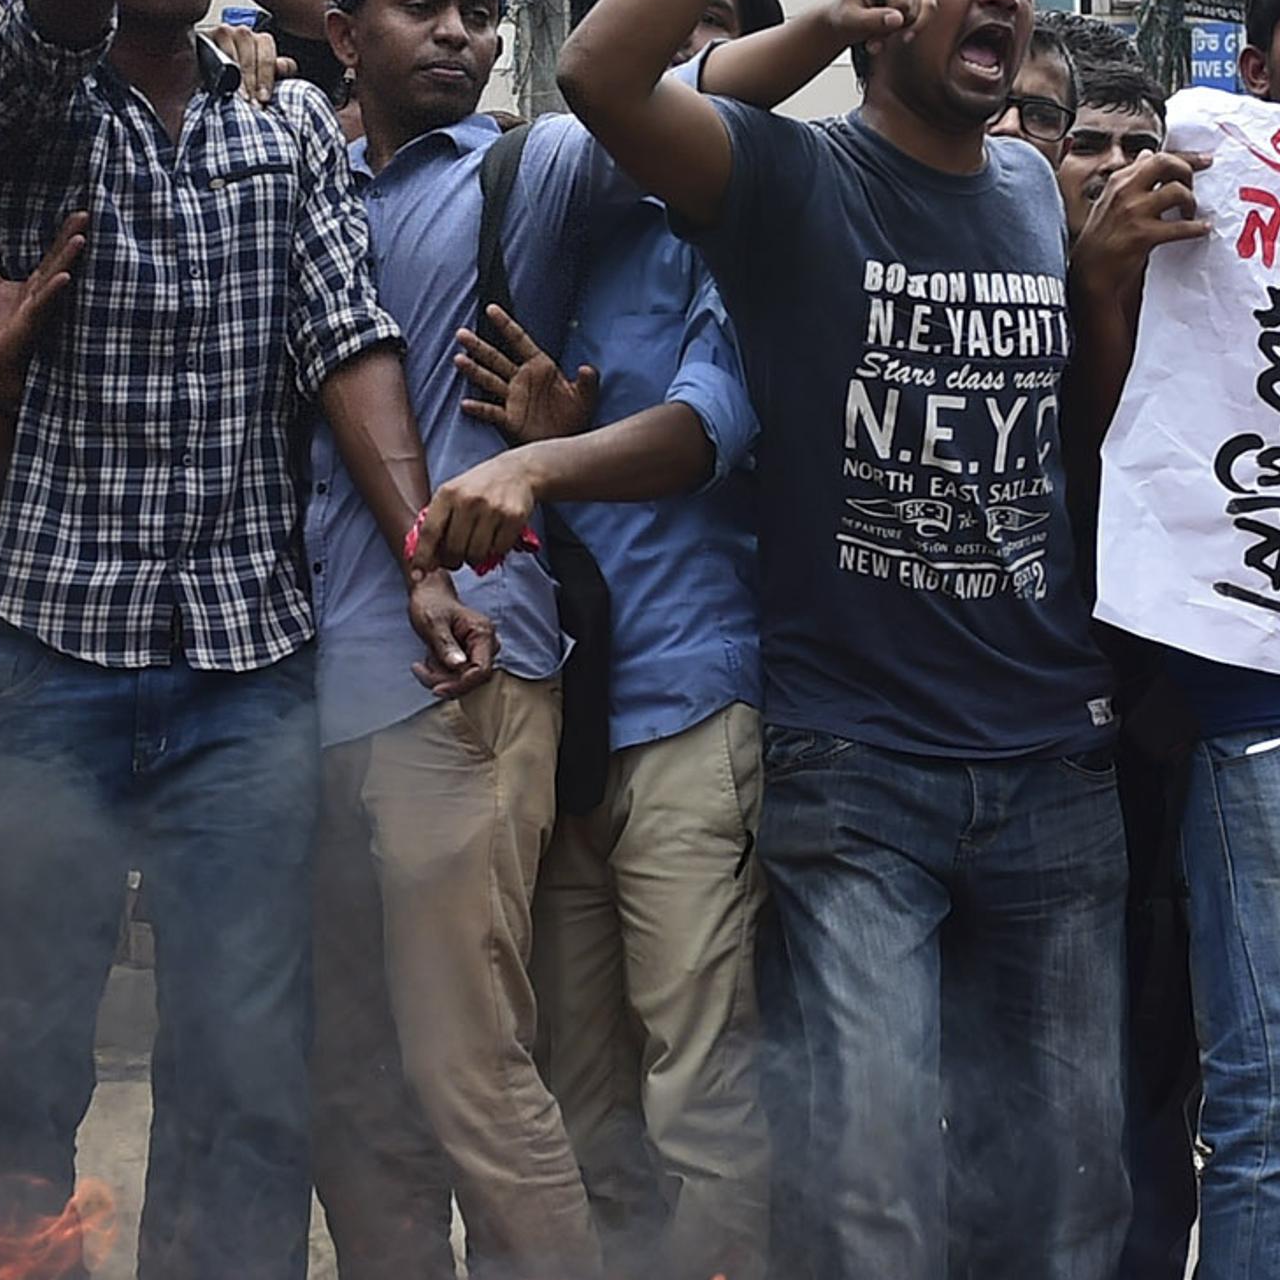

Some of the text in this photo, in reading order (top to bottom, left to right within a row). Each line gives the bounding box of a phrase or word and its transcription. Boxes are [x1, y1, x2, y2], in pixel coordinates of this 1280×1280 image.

[1191, 60, 1221, 78] TIVE
[856, 352, 937, 388] Stars
[946, 363, 1006, 391] class
[843, 457, 914, 494] NORTH
[839, 544, 892, 580] NEW
